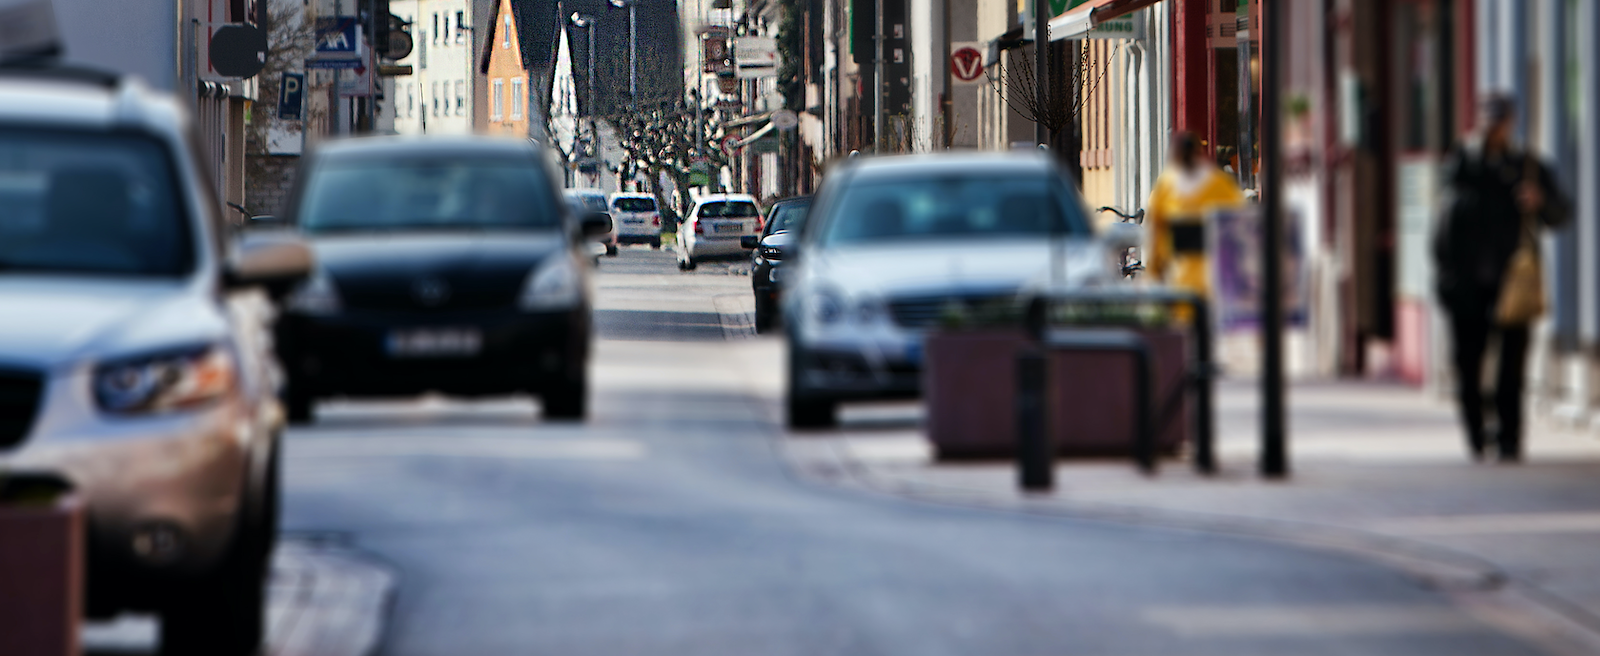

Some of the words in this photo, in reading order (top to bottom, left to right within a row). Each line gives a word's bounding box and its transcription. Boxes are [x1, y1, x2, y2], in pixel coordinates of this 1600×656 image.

[1093, 22, 1133, 33] RUNG
[316, 32, 350, 50] AXA
[284, 77, 299, 104] P
